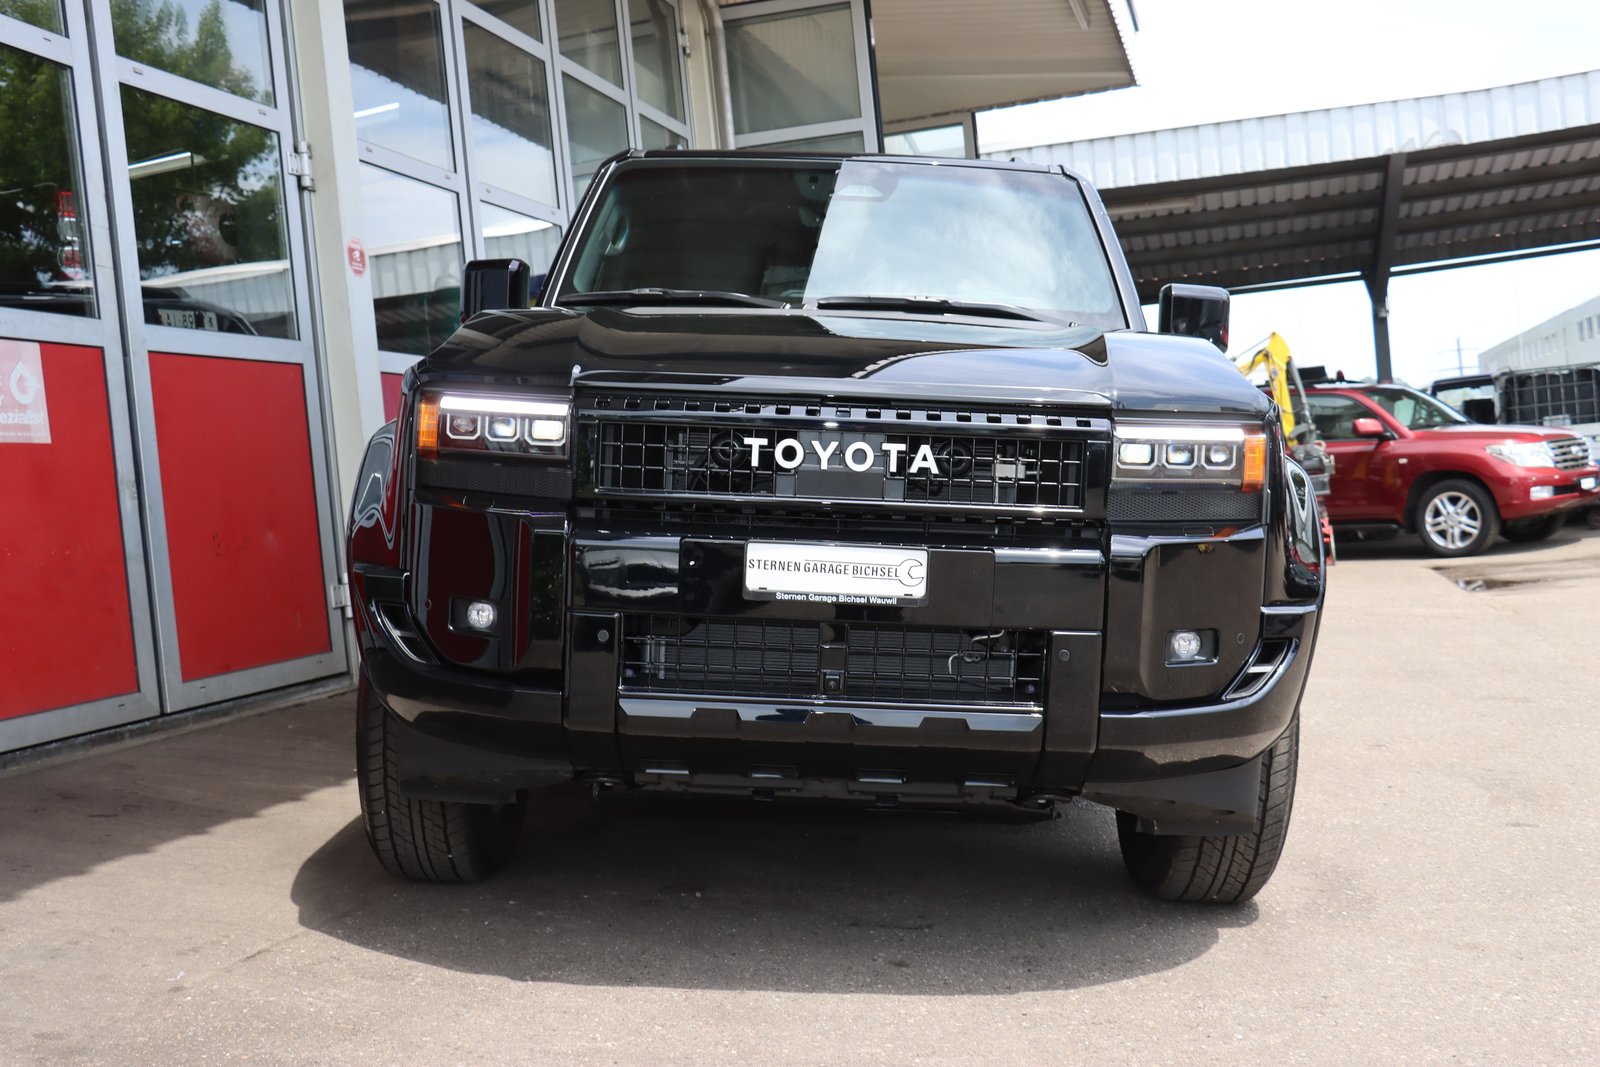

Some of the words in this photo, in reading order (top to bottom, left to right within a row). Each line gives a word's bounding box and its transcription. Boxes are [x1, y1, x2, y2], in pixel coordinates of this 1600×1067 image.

[744, 437, 940, 475] TOYOTA
[748, 558, 801, 572] STERNEN
[803, 562, 849, 575] GARAGE
[852, 564, 900, 578] BICHSEL
[775, 591, 807, 601] Sternen
[808, 593, 837, 604] Garage
[838, 594, 867, 604] Bichsel
[869, 596, 897, 605] Wauwil
